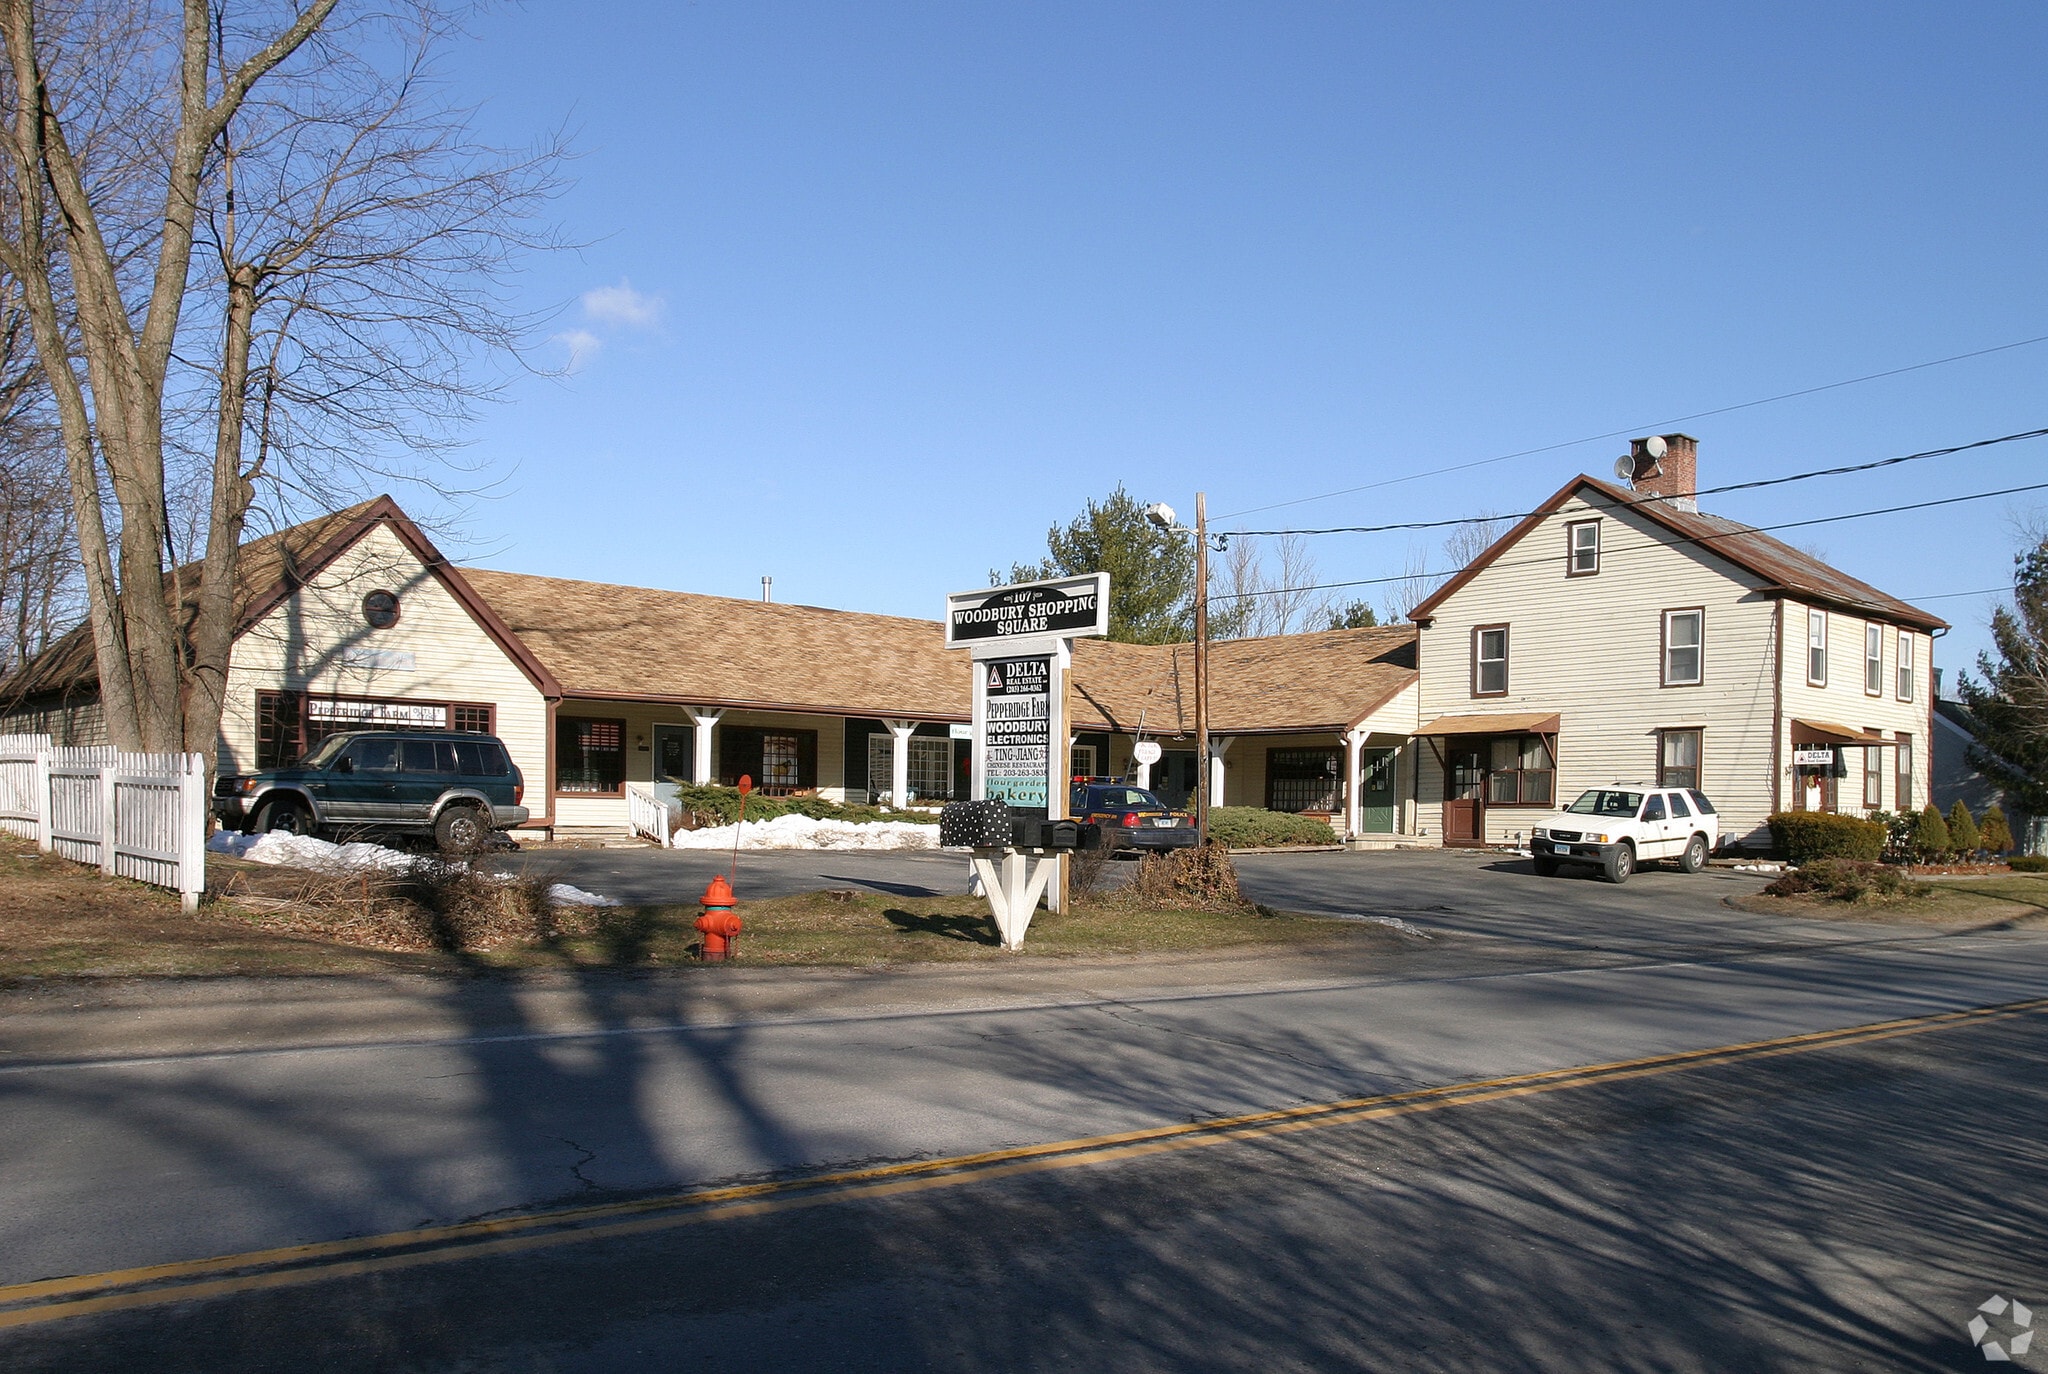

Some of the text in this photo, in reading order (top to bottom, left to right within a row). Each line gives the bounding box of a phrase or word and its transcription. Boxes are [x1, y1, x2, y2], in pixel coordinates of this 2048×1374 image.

[1014, 591, 1031, 603] 107
[954, 595, 1097, 625] WOODBURY SHOPPING
[997, 617, 1048, 635] SQUARE
[1006, 662, 1047, 678] DELTA
[1022, 676, 1042, 684] ESTATE
[987, 720, 1049, 733] WOODBURY
[987, 734, 1049, 745] ELECTRONICS
[995, 747, 1039, 761] TING-JIANG
[1807, 751, 1830, 759] DELTA
[1012, 761, 1048, 769] RESTAURANT
[987, 769, 1002, 777] TEL:
[986, 787, 1048, 805] bakery
